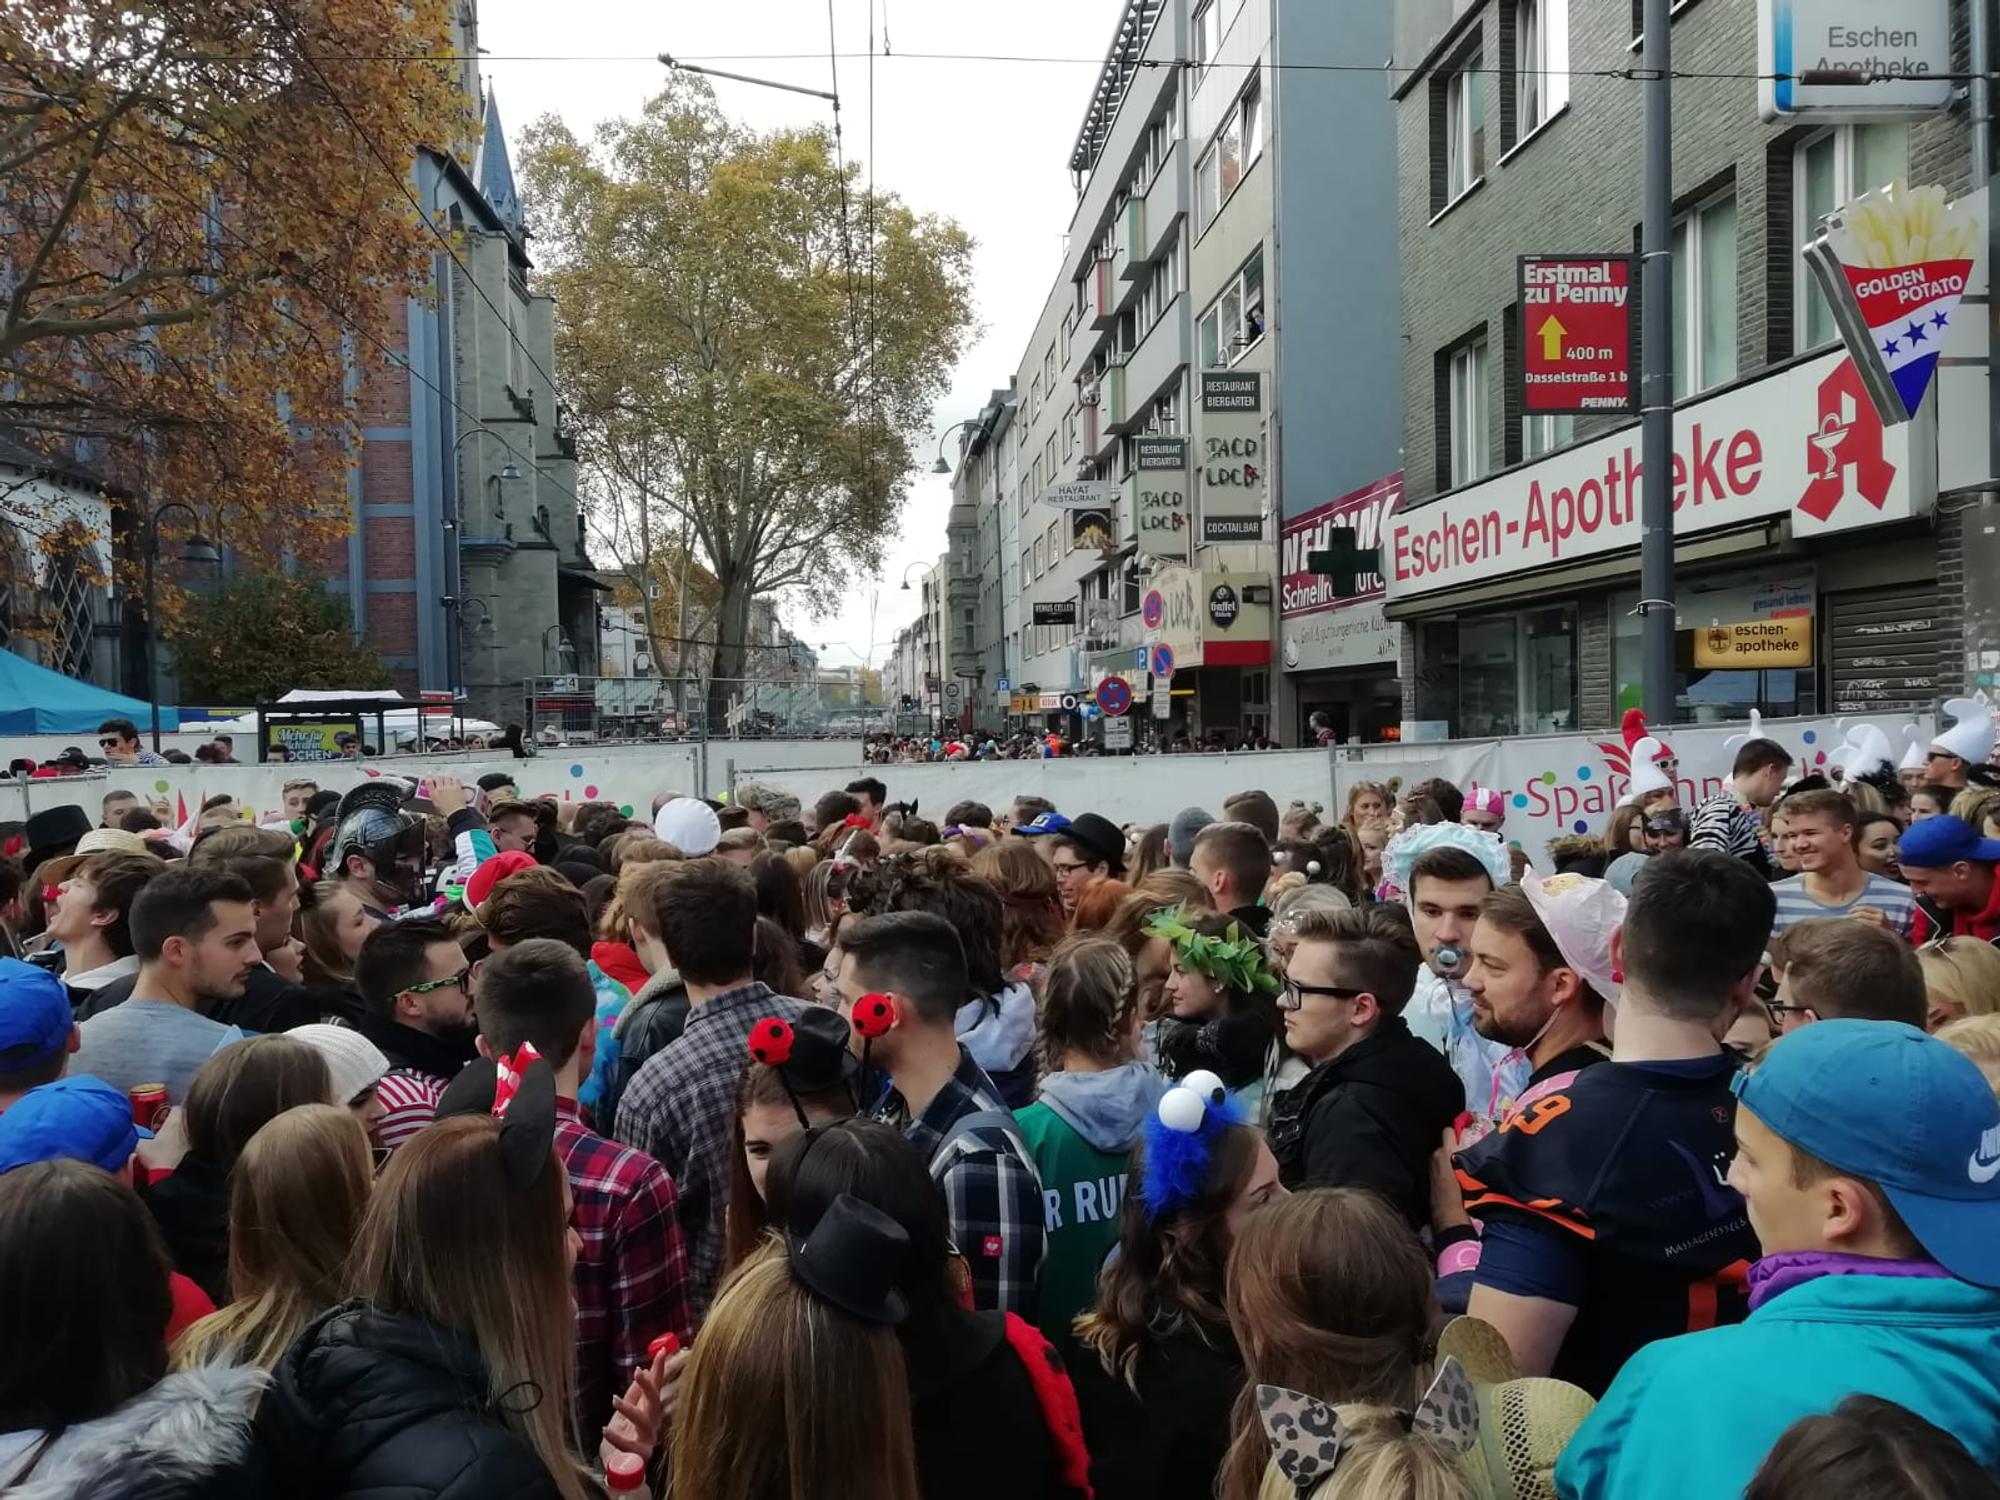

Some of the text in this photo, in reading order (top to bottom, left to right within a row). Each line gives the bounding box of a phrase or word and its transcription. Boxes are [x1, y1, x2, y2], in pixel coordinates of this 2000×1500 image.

[1828, 26, 1917, 48] Eschen
[1524, 262, 1611, 284] Erstmal
[1856, 268, 1925, 298] GOLDEN
[1898, 275, 1962, 304] POTATO
[1524, 284, 1628, 307] zu Penny
[1566, 347, 1613, 360] 400 m
[1525, 371, 1628, 384] Dasselstraße 1 b
[1206, 381, 1256, 392] RESTAURANT
[1207, 396, 1255, 407] BIERGARTEN
[1141, 445, 1181, 454] RESTAURANT
[1141, 458, 1181, 466] BIERGARTEN
[1059, 486, 1090, 495] HAYAT
[1047, 495, 1101, 503] RESTAURANT
[1207, 522, 1259, 533] COCKTAILBAR
[1735, 624, 1789, 636] eschen-
[1735, 640, 1799, 655] apotheke
[1000, 680, 1008, 690] P
[289, 750, 332, 761] OCHEN
